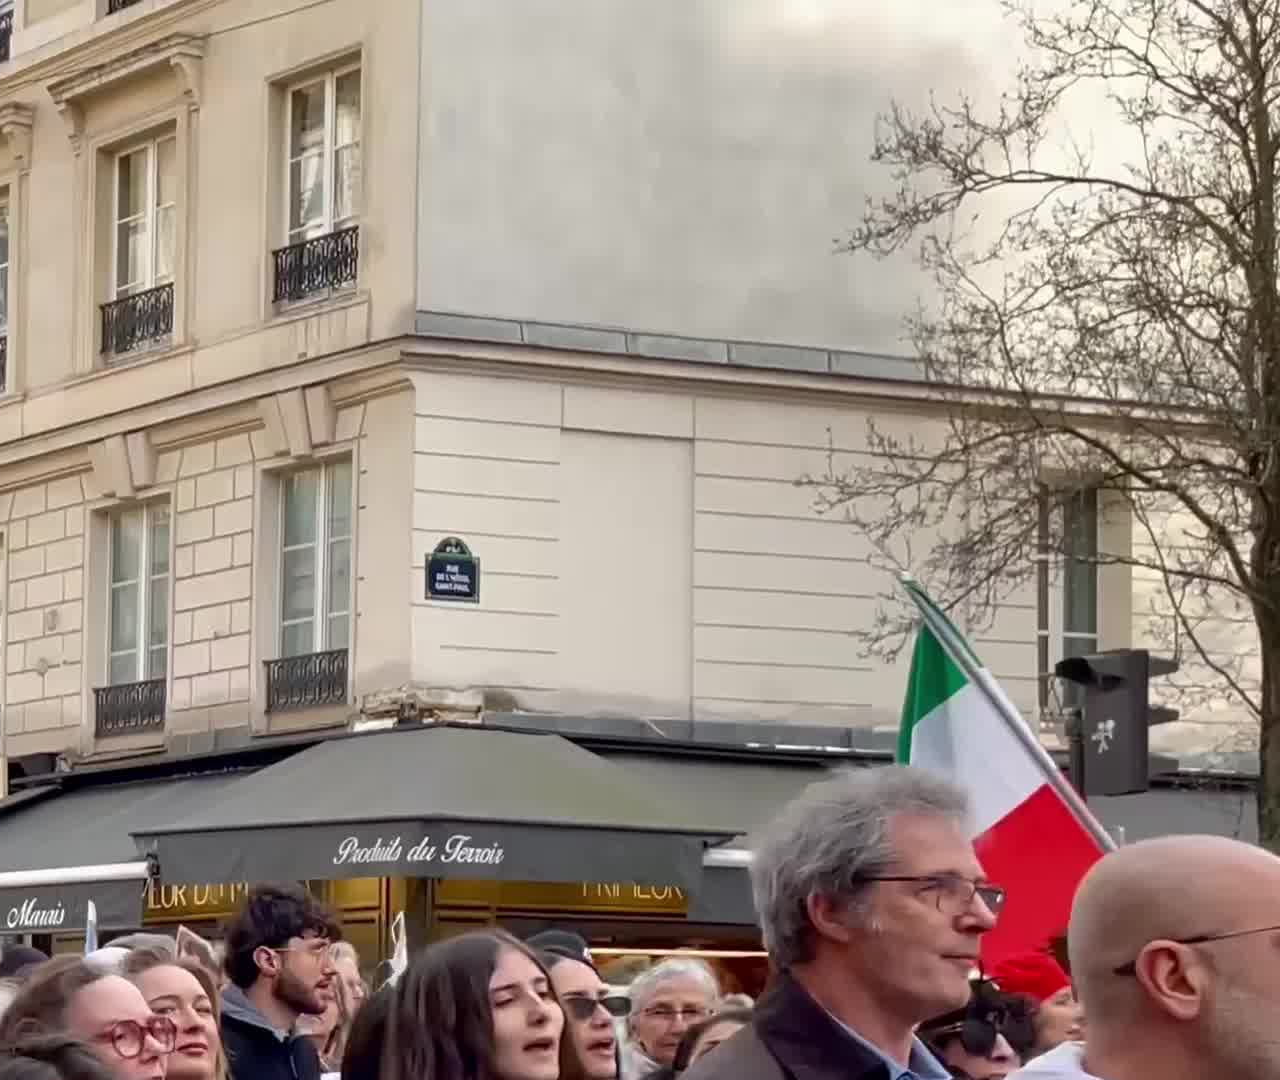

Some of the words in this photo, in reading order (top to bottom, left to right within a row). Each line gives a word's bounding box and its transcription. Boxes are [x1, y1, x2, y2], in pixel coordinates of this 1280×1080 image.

[333, 836, 403, 865] Produits
[406, 836, 437, 862] du
[440, 834, 505, 865] Terroir
[6, 897, 66, 929] Marais
